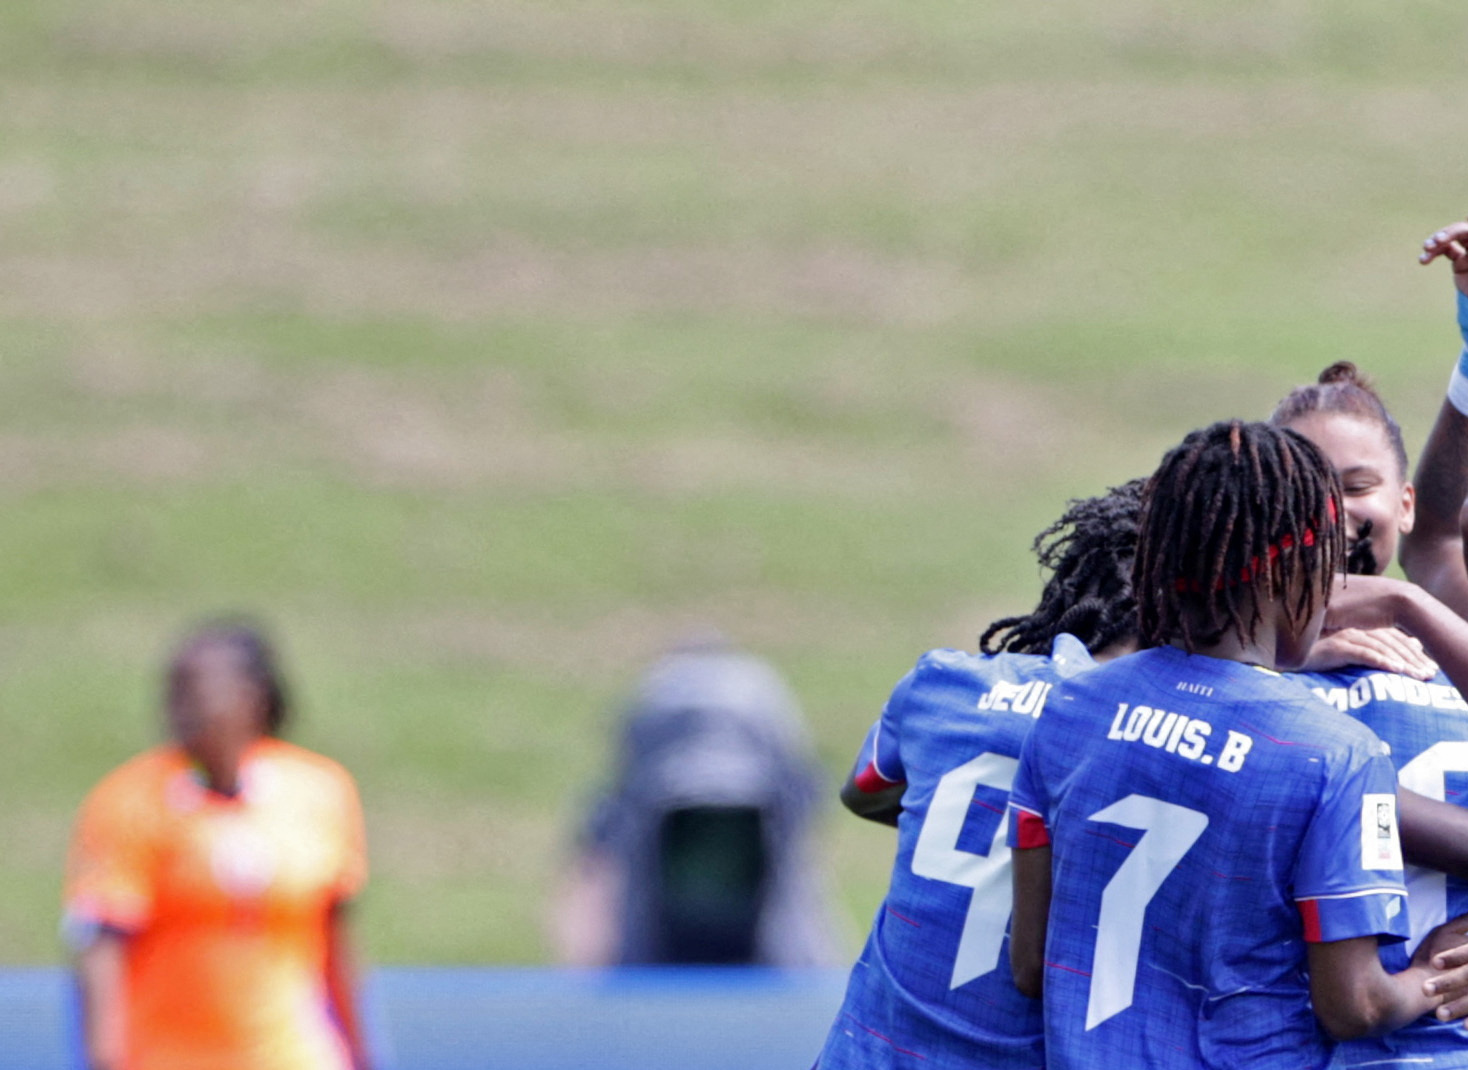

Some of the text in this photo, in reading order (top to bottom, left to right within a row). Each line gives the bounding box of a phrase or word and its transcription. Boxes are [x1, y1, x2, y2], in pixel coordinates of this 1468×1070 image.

[1107, 702, 1253, 773] LOUIS.B
[911, 752, 1018, 990] 9
[1085, 793, 1209, 1032] 7
